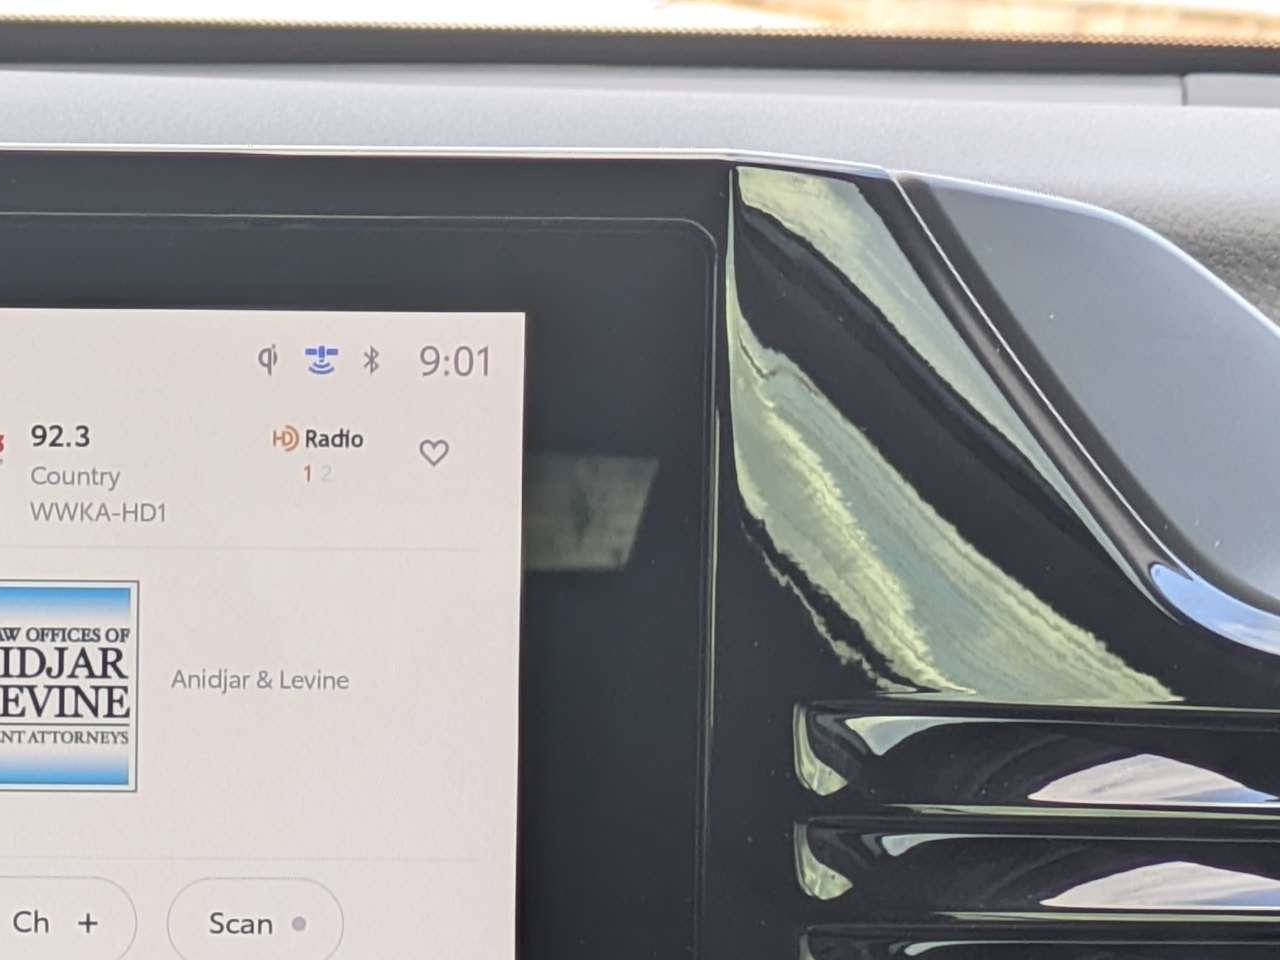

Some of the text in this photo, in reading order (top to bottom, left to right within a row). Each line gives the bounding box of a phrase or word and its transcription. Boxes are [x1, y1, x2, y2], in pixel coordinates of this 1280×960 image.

[419, 344, 490, 377] 9:01
[30, 424, 91, 449] 92.3
[305, 427, 364, 449] Radio
[30, 466, 121, 491] Country
[303, 463, 311, 483] 1
[29, 502, 166, 524] WWKA-HD1
[25, 627, 101, 643] OFFICES
[105, 627, 130, 643] OF
[170, 668, 350, 694] Anidjar & Levine
[27, 731, 130, 745] ATTORNEYS
[13, 910, 50, 936] Ch
[208, 911, 274, 936] Scan
